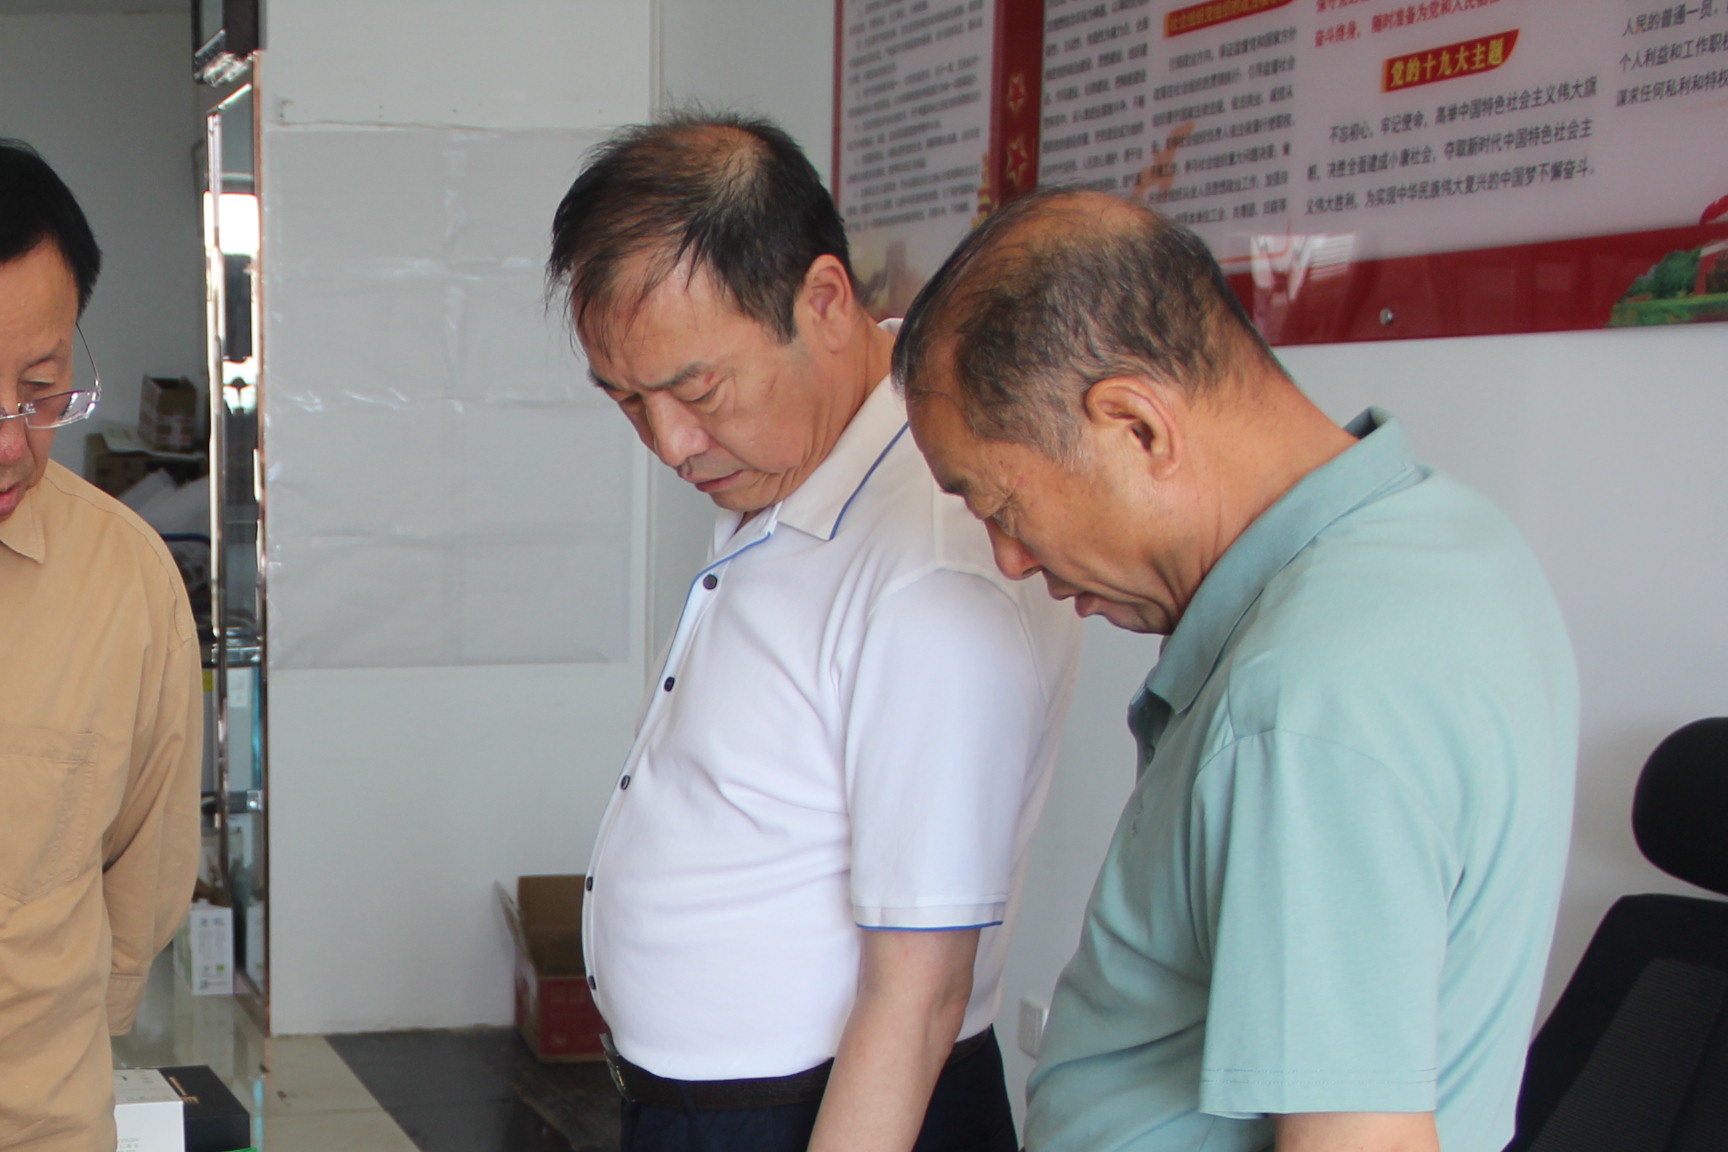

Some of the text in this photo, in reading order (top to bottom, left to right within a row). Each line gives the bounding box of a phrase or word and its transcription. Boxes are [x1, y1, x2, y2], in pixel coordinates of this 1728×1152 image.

[1390, 38, 1505, 88] 党的十九大主题
